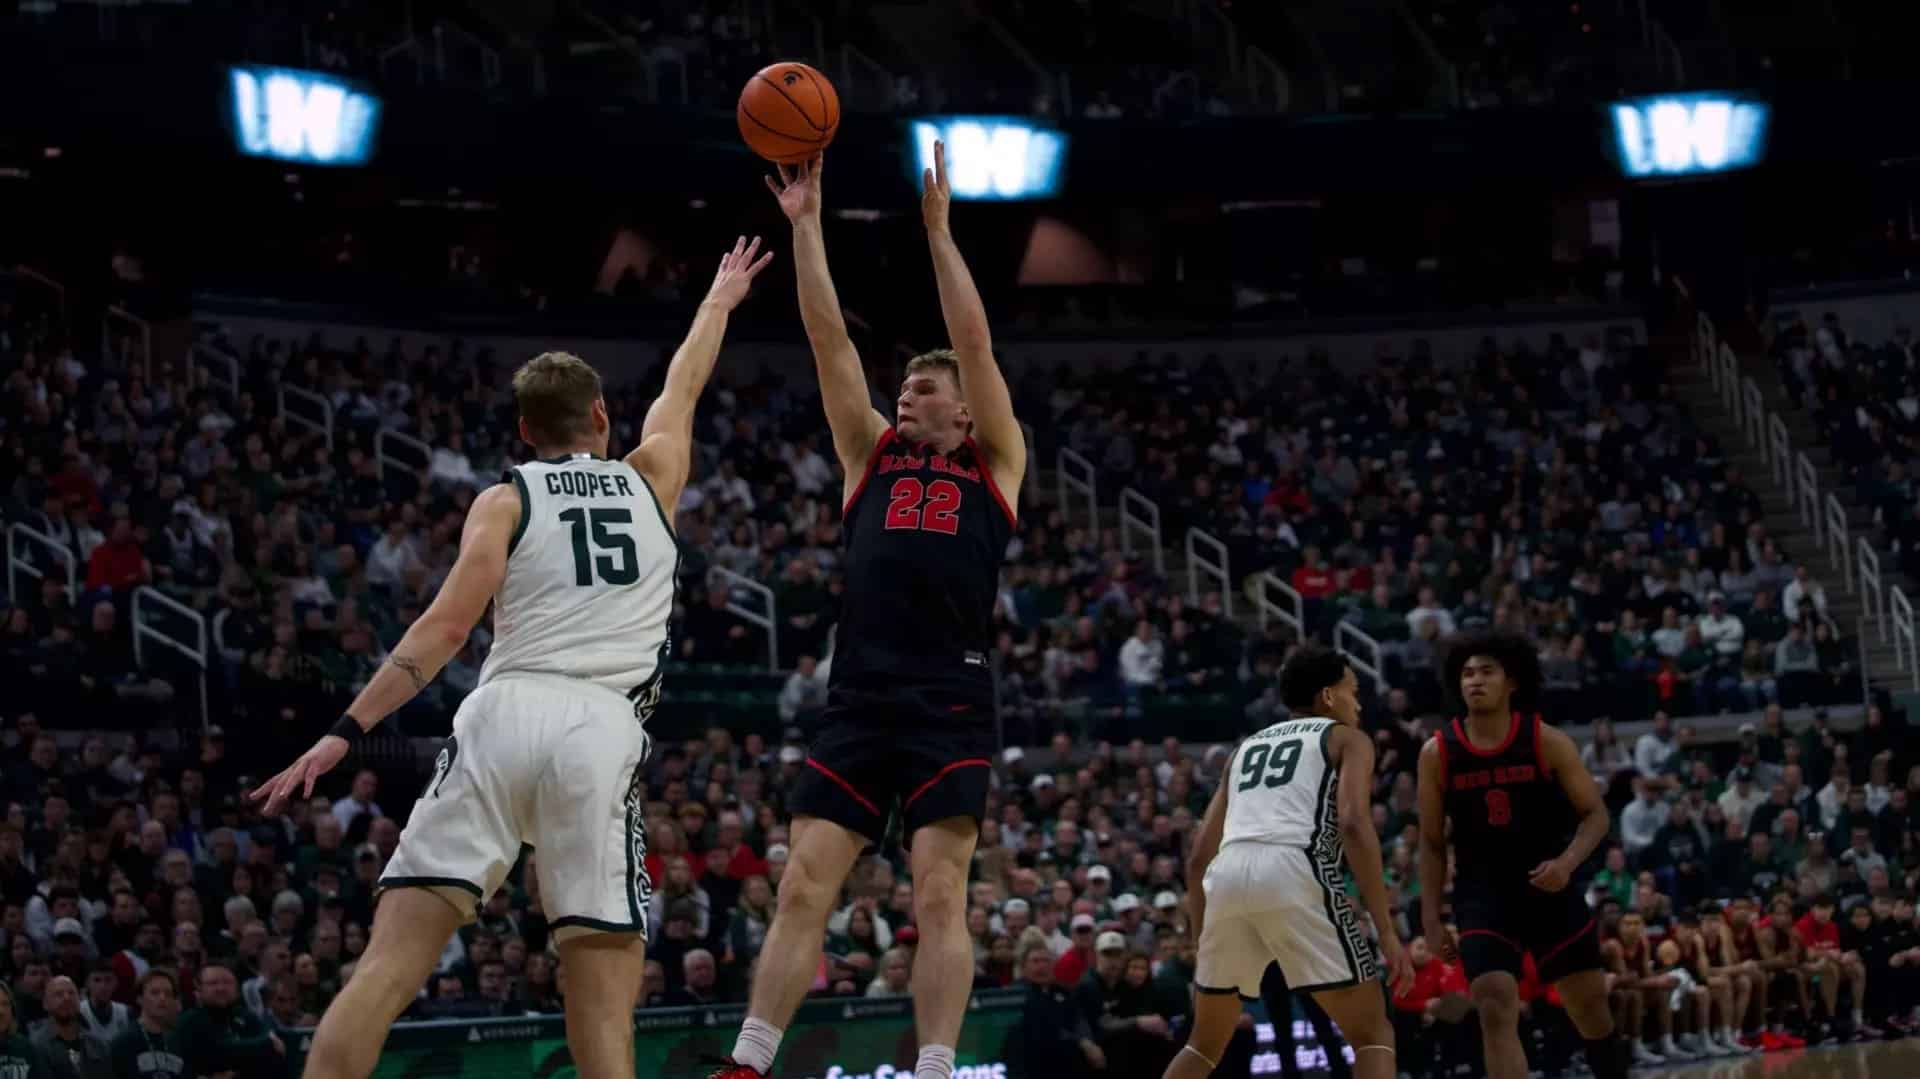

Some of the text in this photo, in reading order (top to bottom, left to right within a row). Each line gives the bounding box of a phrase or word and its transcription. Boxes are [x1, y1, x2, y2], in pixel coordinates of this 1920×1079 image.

[545, 471, 634, 498] COOPER
[884, 476, 962, 536] 22
[558, 507, 640, 586] 15
[1239, 739, 1304, 792] 99
